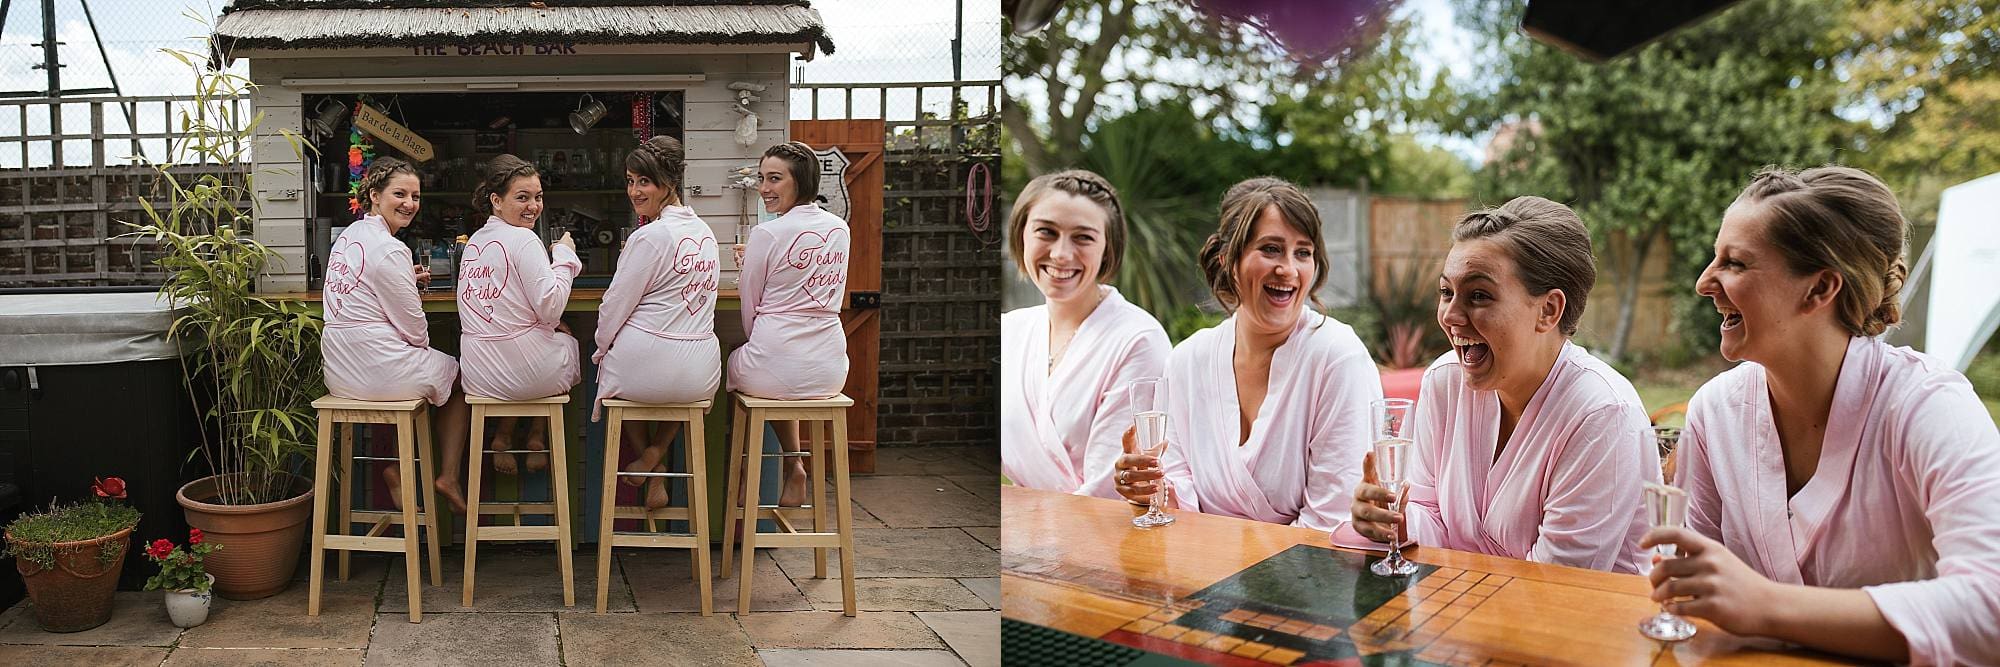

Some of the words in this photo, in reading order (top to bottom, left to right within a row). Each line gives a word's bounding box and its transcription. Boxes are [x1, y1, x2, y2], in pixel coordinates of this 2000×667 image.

[457, 42, 525, 56] BEACH
[535, 42, 576, 55] BAR
[361, 110, 380, 128] Bar
[379, 121, 392, 136] de
[391, 127, 401, 141] la
[401, 134, 426, 156] Plage
[459, 258, 495, 281] Team
[799, 245, 844, 270] Team
